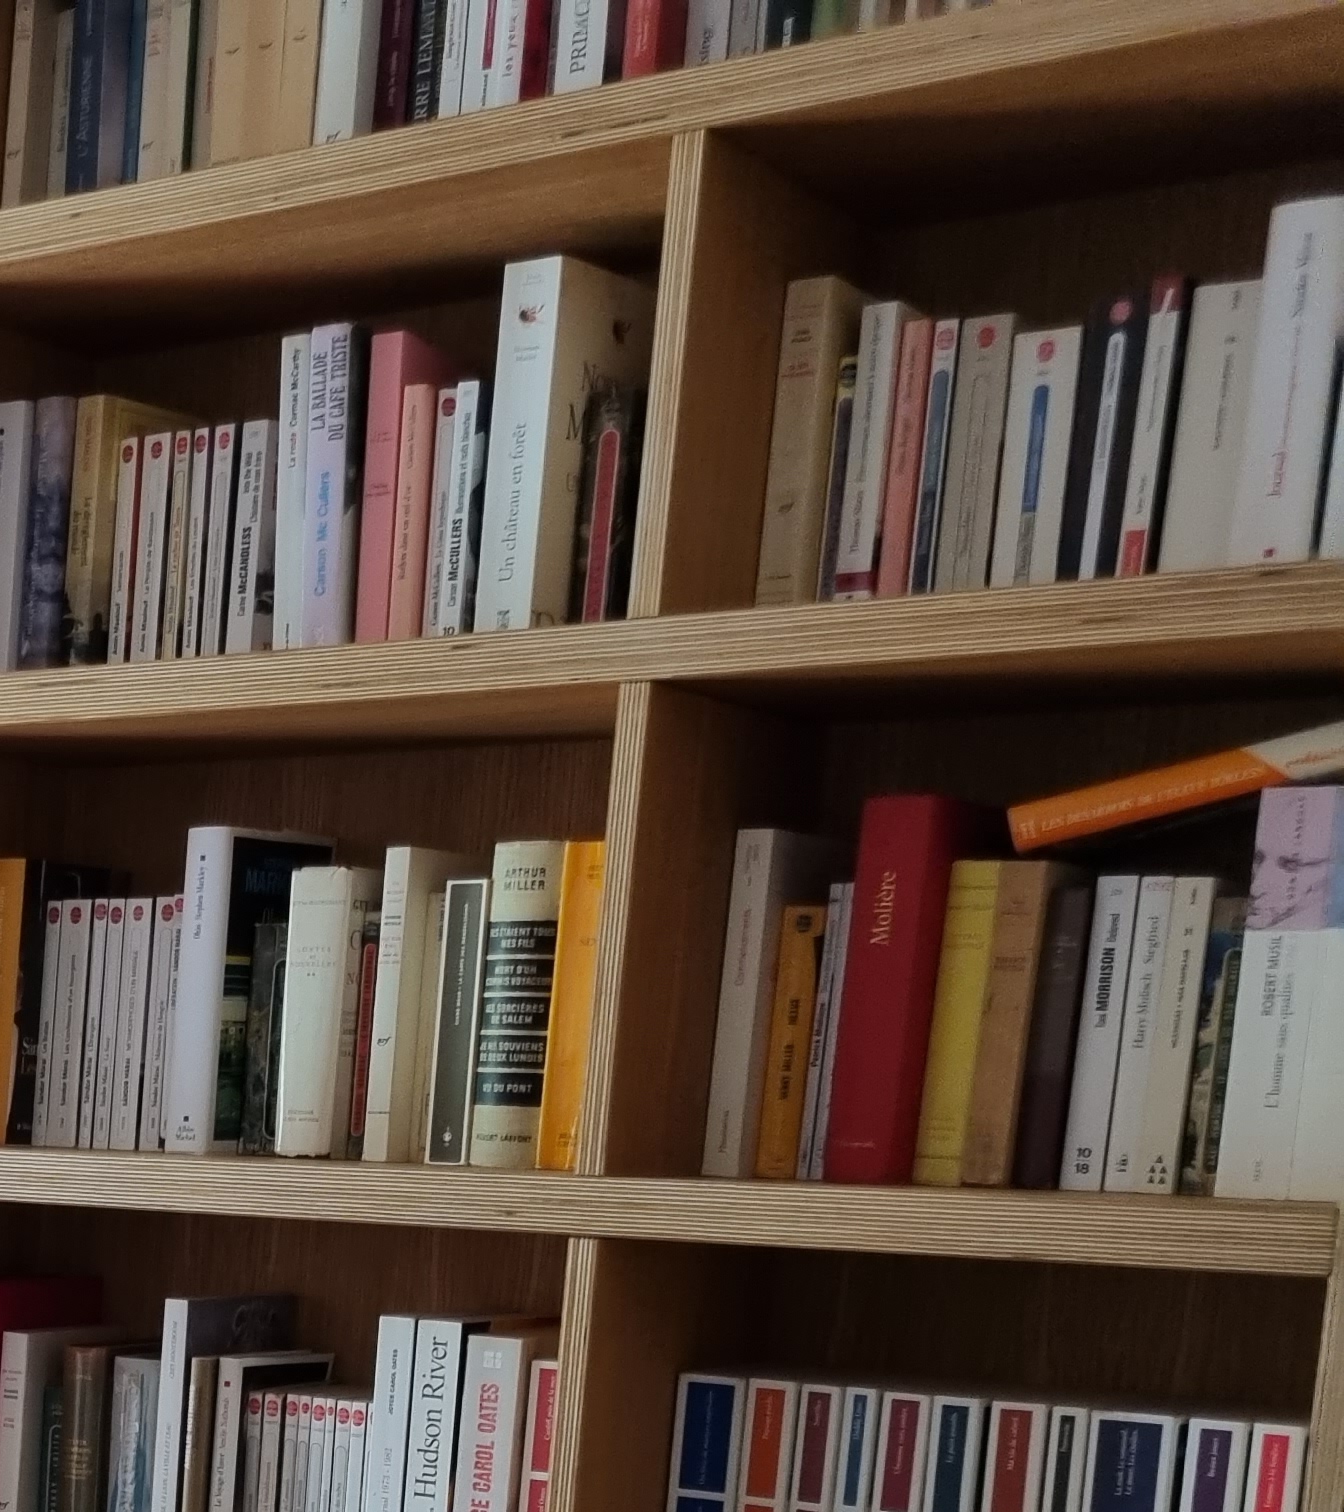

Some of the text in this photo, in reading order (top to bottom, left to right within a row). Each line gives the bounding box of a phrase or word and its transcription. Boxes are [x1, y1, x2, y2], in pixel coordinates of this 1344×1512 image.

[288, 348, 302, 468] La route Cormac McCarthy
[311, 351, 327, 431] LA BALLADE
[328, 334, 348, 441] DU CAFE TRISTE
[314, 471, 331, 597] Carson Mc Cullers
[498, 422, 527, 582] Un château en forêt
[237, 526, 252, 594] McCANDLESS
[503, 867, 546, 891] ARTHUR MILLER
[869, 871, 897, 945] Molière
[1105, 913, 1121, 943] Beloved
[1095, 948, 1116, 1011] MORRISON
[1131, 916, 1162, 1049] Harry Mulisch Siegfried
[1260, 935, 1283, 1017] ROBERT MUSIL
[502, 1014, 532, 1024] SALEM
[506, 1083, 532, 1092] PONT
[413, 1336, 448, 1499] Hudson River
[477, 1382, 500, 1433] OATES
[472, 1440, 495, 1493] CAROL
